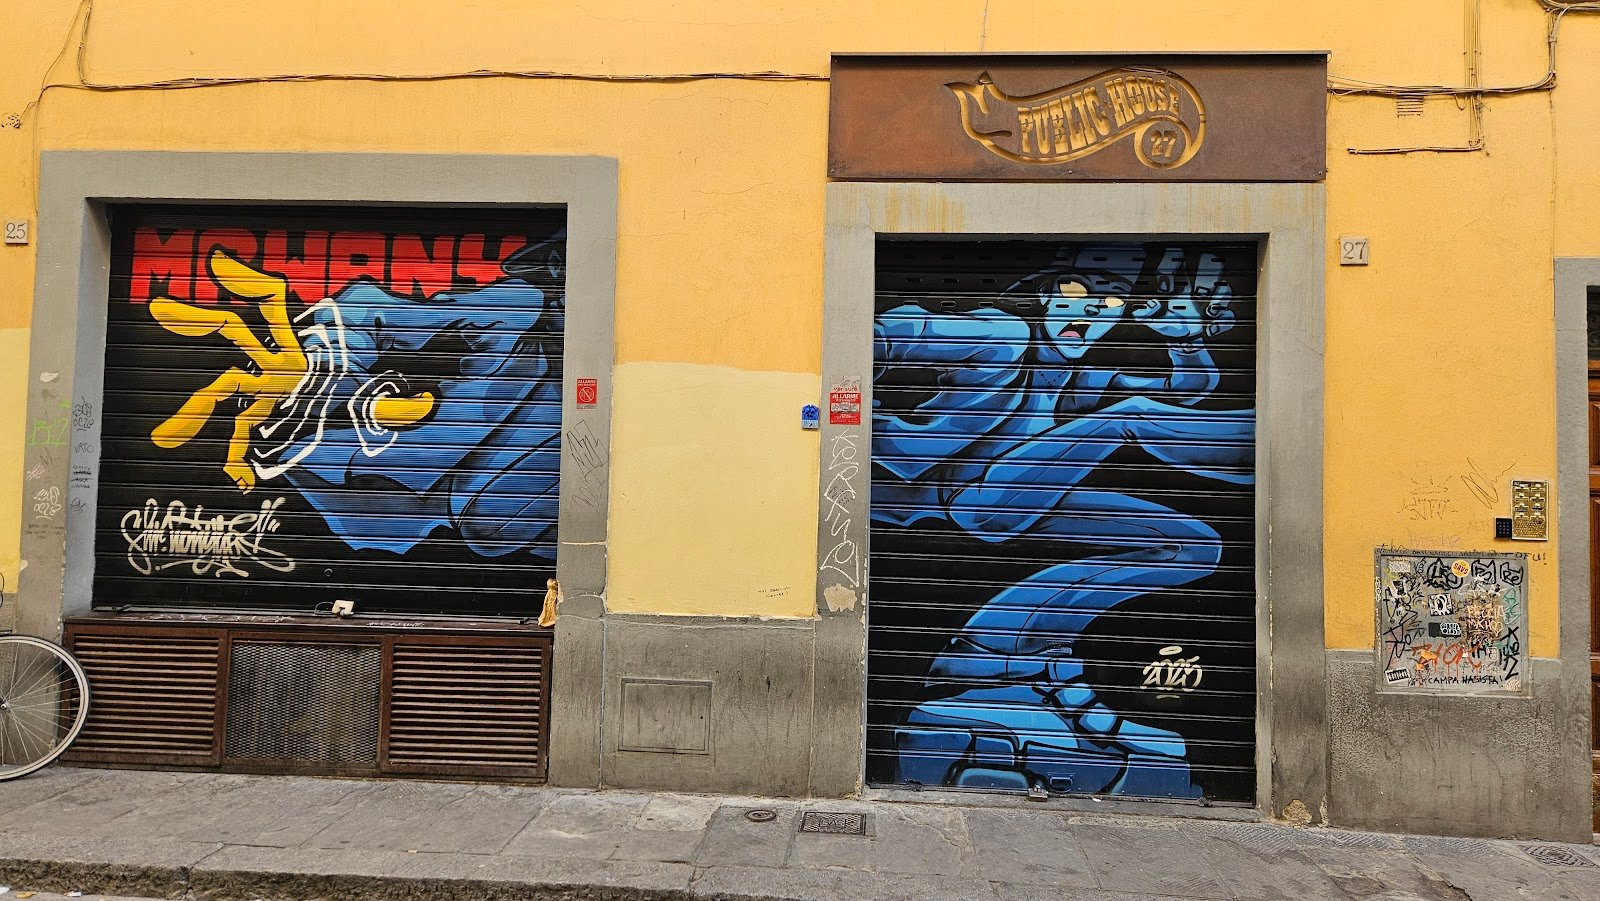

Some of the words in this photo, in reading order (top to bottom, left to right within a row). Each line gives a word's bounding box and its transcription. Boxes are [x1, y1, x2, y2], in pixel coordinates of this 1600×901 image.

[1017, 86, 1111, 155] PUBLIC
[1105, 75, 1180, 128] HOUSE
[1150, 129, 1178, 158] 27
[5, 222, 26, 240] 25
[1343, 240, 1367, 260] 27
